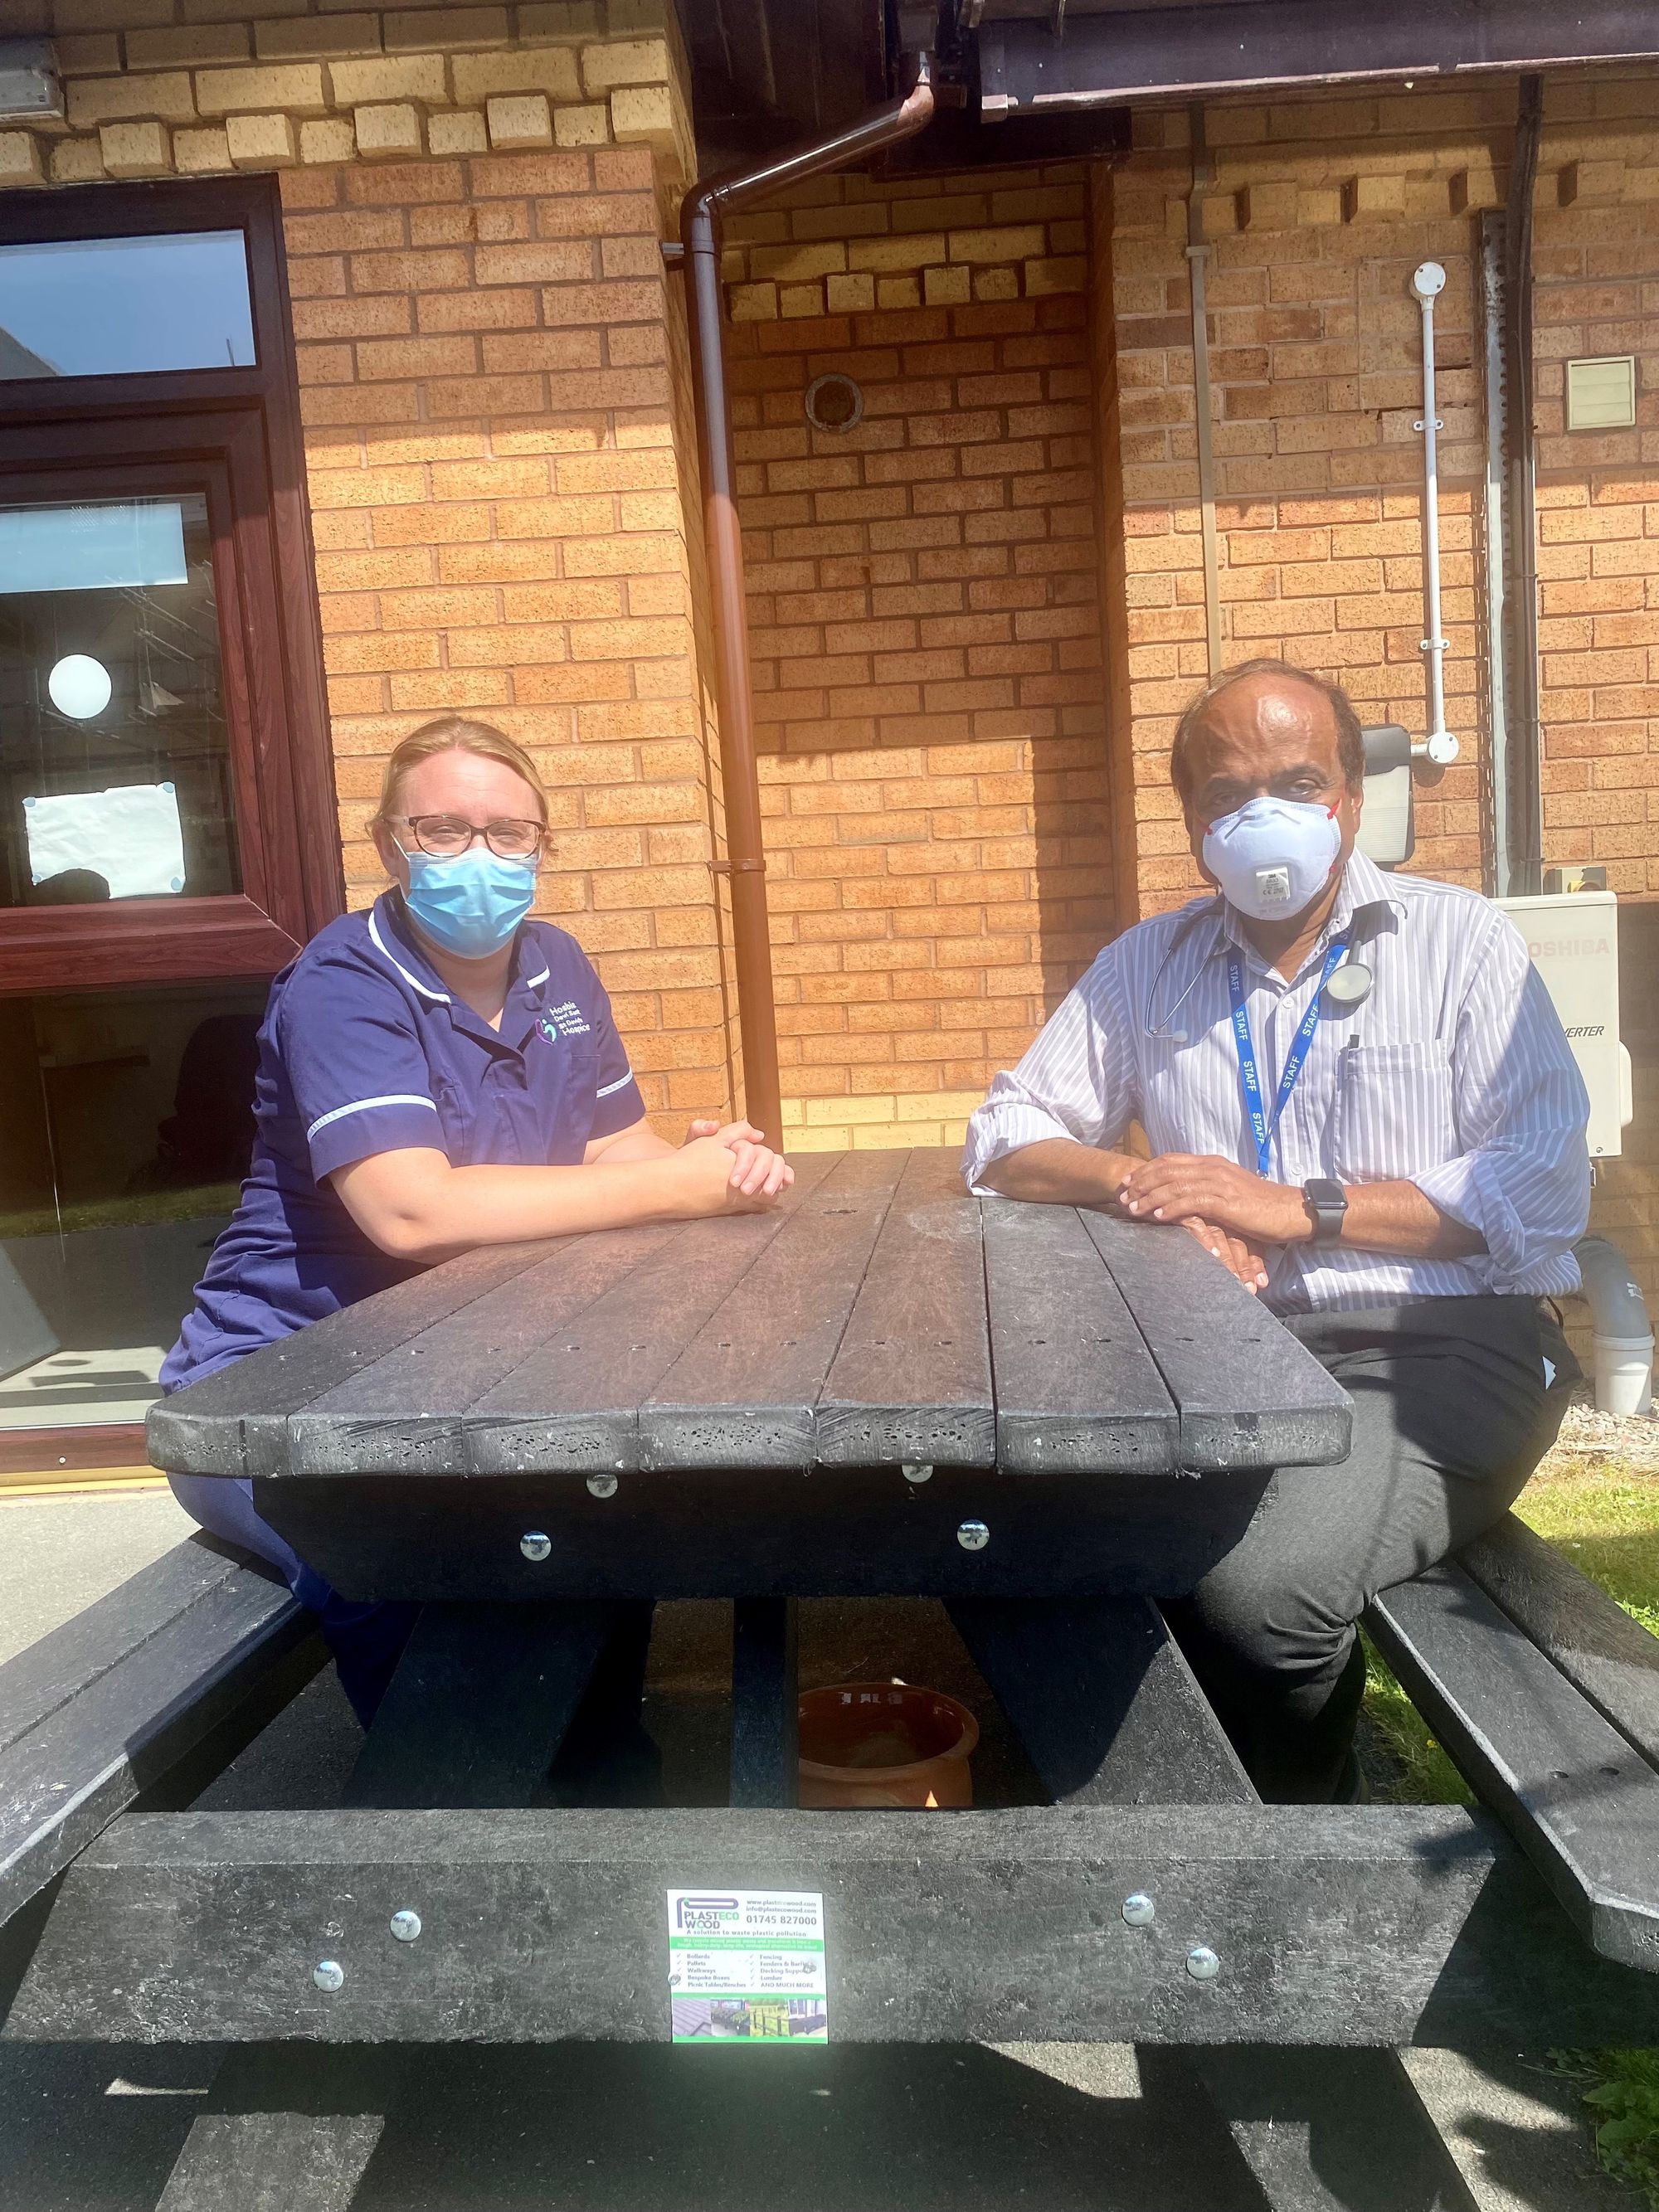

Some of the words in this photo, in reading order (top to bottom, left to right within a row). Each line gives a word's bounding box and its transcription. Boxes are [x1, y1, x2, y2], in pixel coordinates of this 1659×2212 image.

[1527, 938, 1610, 958] OSHIBA
[562, 1023, 591, 1036] Hospice
[1282, 1055, 1301, 1089] STAFF
[1301, 1004, 1320, 1037] STAFF
[1229, 964, 1240, 993] STAFF
[1235, 1010, 1248, 1041] STAFF
[1243, 1060, 1258, 1092] STAFF
[1252, 1111, 1265, 1145] STAFF
[684, 1911, 740, 1921] PLASTECO
[747, 1914, 776, 1924] 01745
[780, 1916, 817, 1925] 827000
[685, 1920, 721, 1929] WOOD
